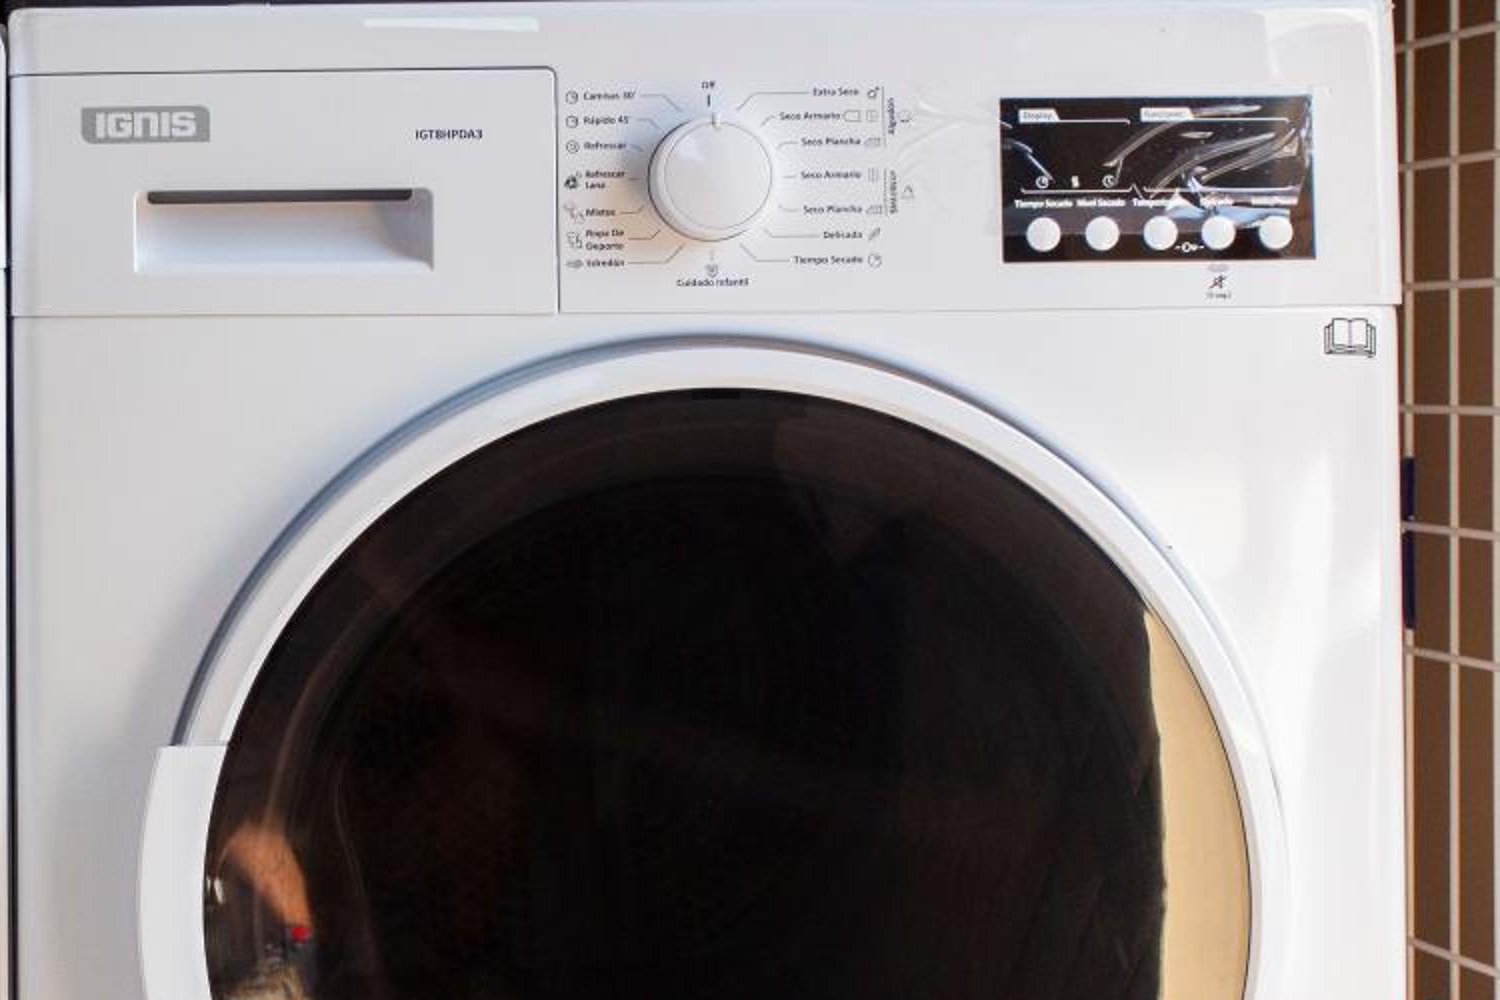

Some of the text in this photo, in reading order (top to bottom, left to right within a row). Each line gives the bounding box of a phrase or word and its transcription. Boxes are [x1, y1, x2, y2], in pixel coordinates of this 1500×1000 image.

[812, 87, 859, 96] Extra Seco
[779, 112, 841, 121] Seco Armario
[95, 111, 197, 139] IGNIS
[801, 137, 861, 146] Seco Plancha
[801, 171, 862, 180] Seco Armario
[803, 205, 863, 214] Seco Plancha
[795, 256, 863, 266] Tiempo Secado
[676, 279, 715, 288] Cuidado
